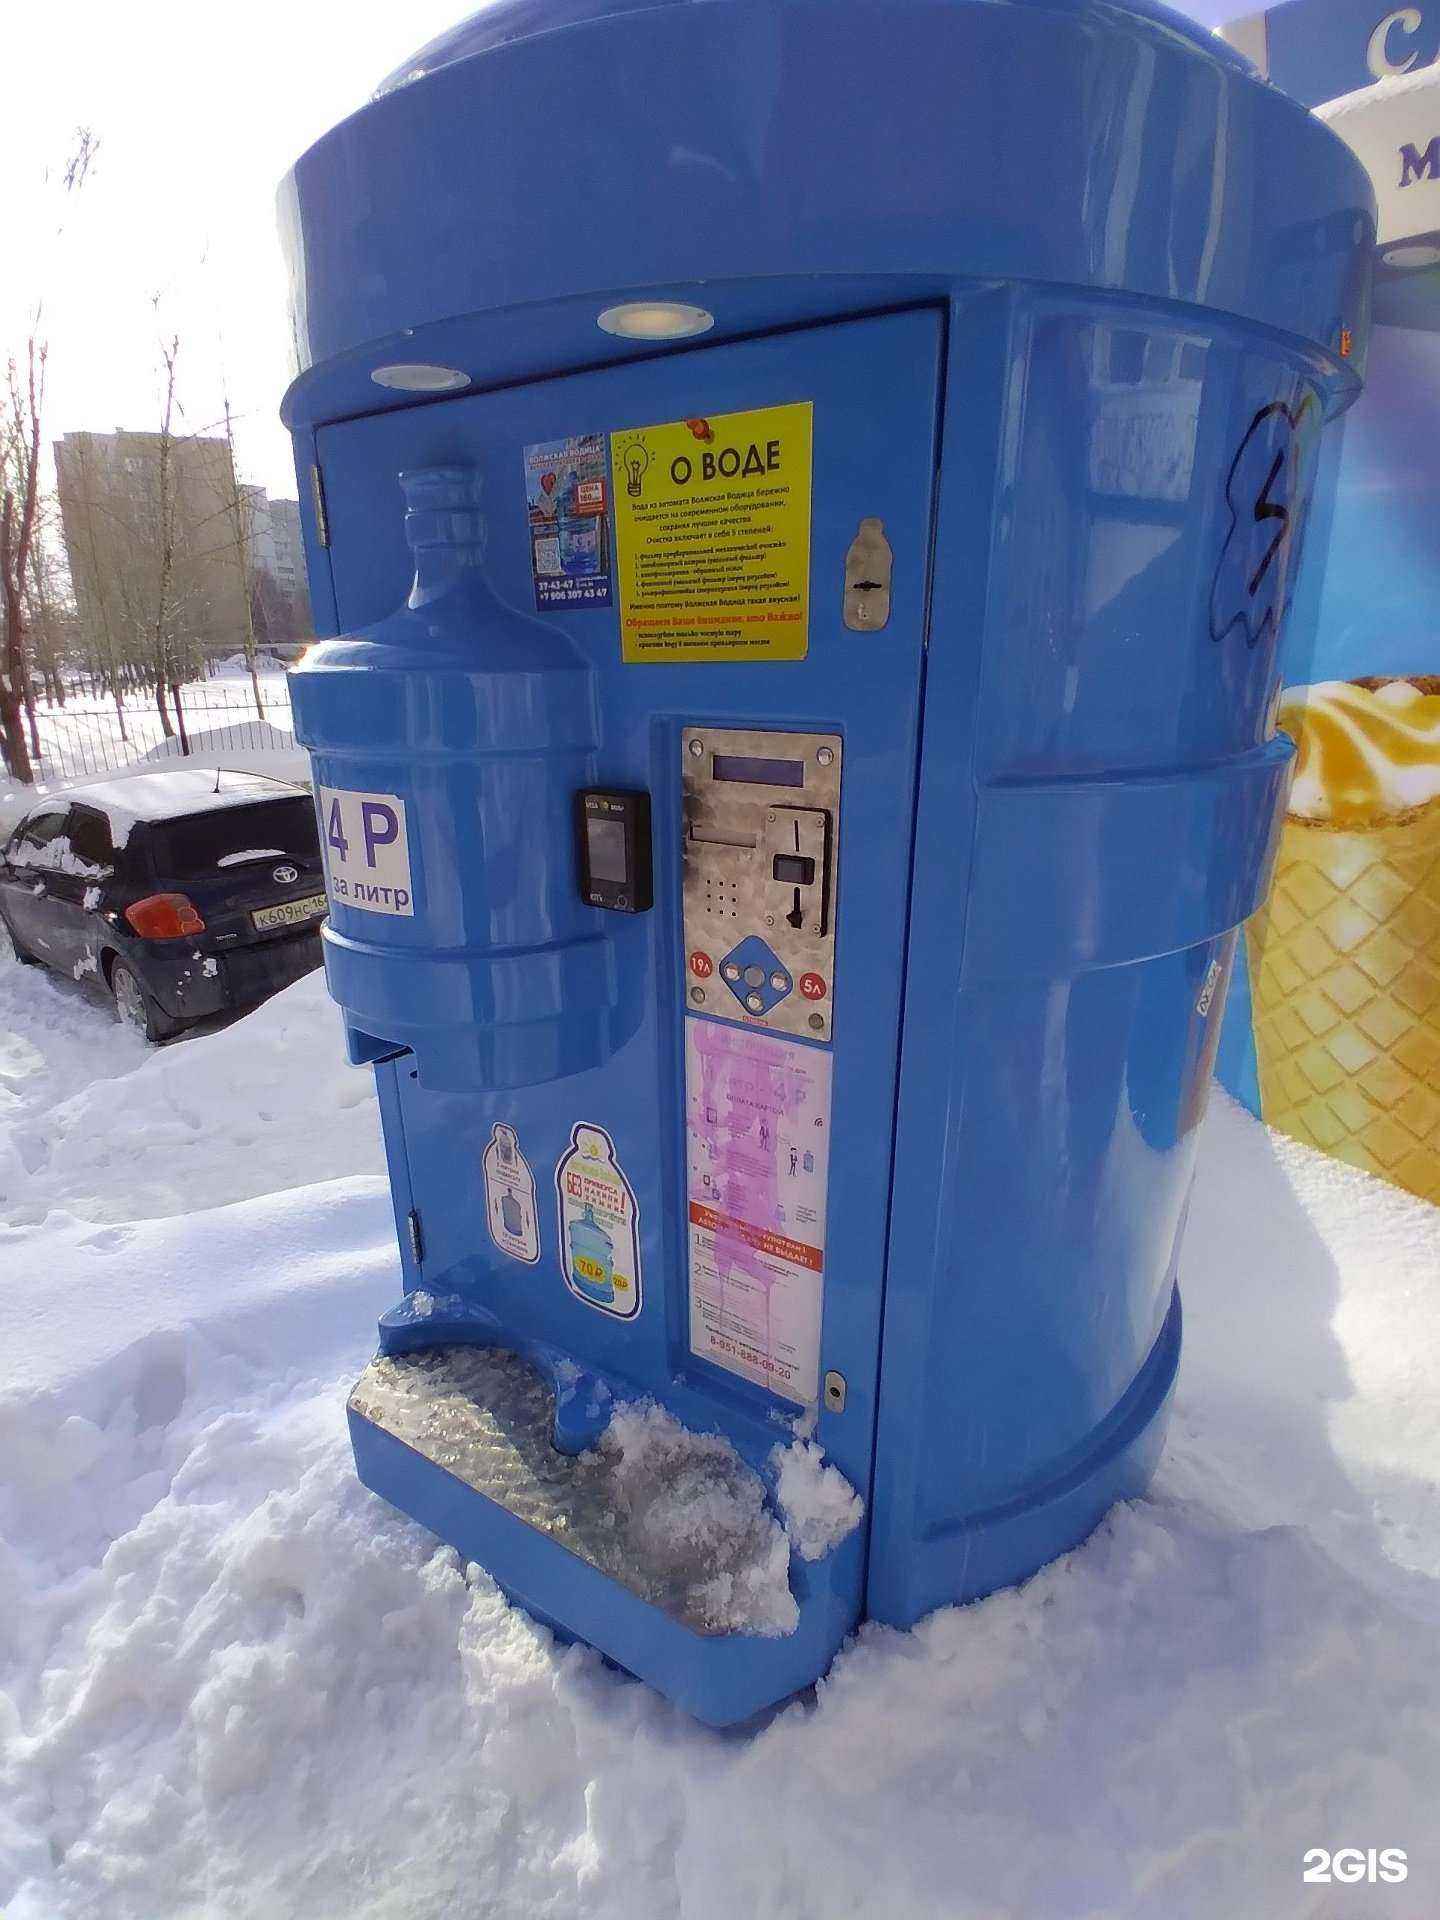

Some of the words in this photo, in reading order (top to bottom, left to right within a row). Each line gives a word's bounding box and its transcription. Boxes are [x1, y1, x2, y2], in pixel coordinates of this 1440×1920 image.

[670, 456, 692, 484] О
[702, 440, 780, 481] ВОДЕ
[691, 493, 725, 505] Волжская
[727, 490, 754, 501] Водица
[328, 797, 349, 862] 4
[333, 876, 349, 897] за
[354, 882, 410, 911] литр
[566, 1171, 583, 1198] БЕЗ
[710, 1335, 791, 1380] 8-951-888-09-20
